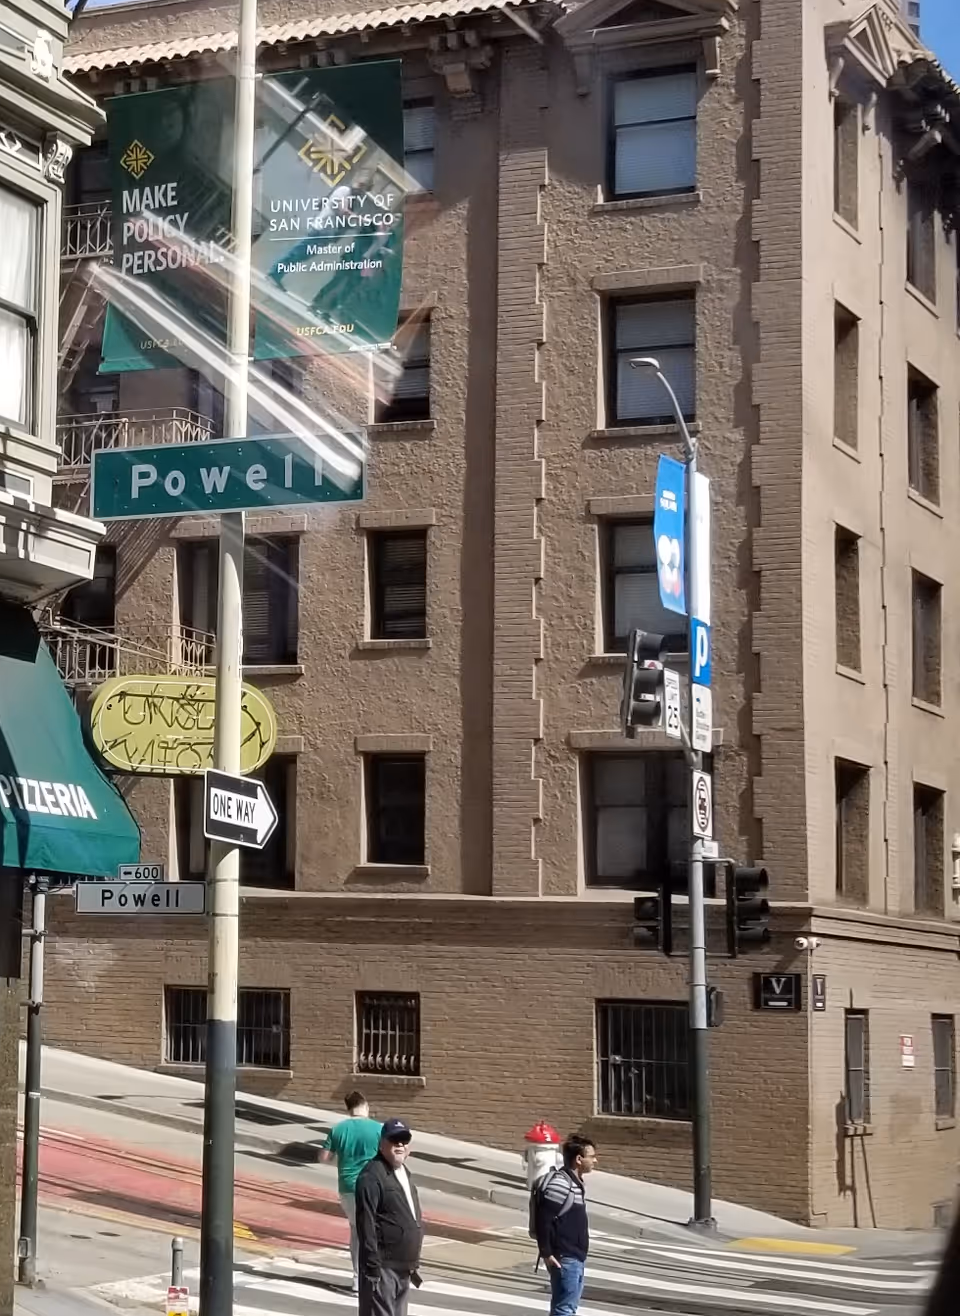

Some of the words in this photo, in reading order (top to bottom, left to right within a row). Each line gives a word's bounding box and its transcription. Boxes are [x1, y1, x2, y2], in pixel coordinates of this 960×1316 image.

[122, 182, 178, 214] MAKE
[270, 194, 367, 213] UNIVERSITY
[373, 193, 395, 208] OF
[122, 212, 189, 245] POLICY
[269, 218, 300, 231] SAN
[306, 212, 394, 230] FRANCISCO
[306, 244, 341, 255] Master
[344, 242, 355, 253] of
[277, 262, 307, 274] Public
[309, 259, 382, 272] Administration
[131, 453, 323, 499] Powell
[668, 705, 679, 730] 25
[213, 793, 232, 819] ONE
[236, 798, 256, 824] WAY
[135, 867, 159, 879] 600
[101, 889, 180, 907] Powell
[768, 977, 788, 995] V
